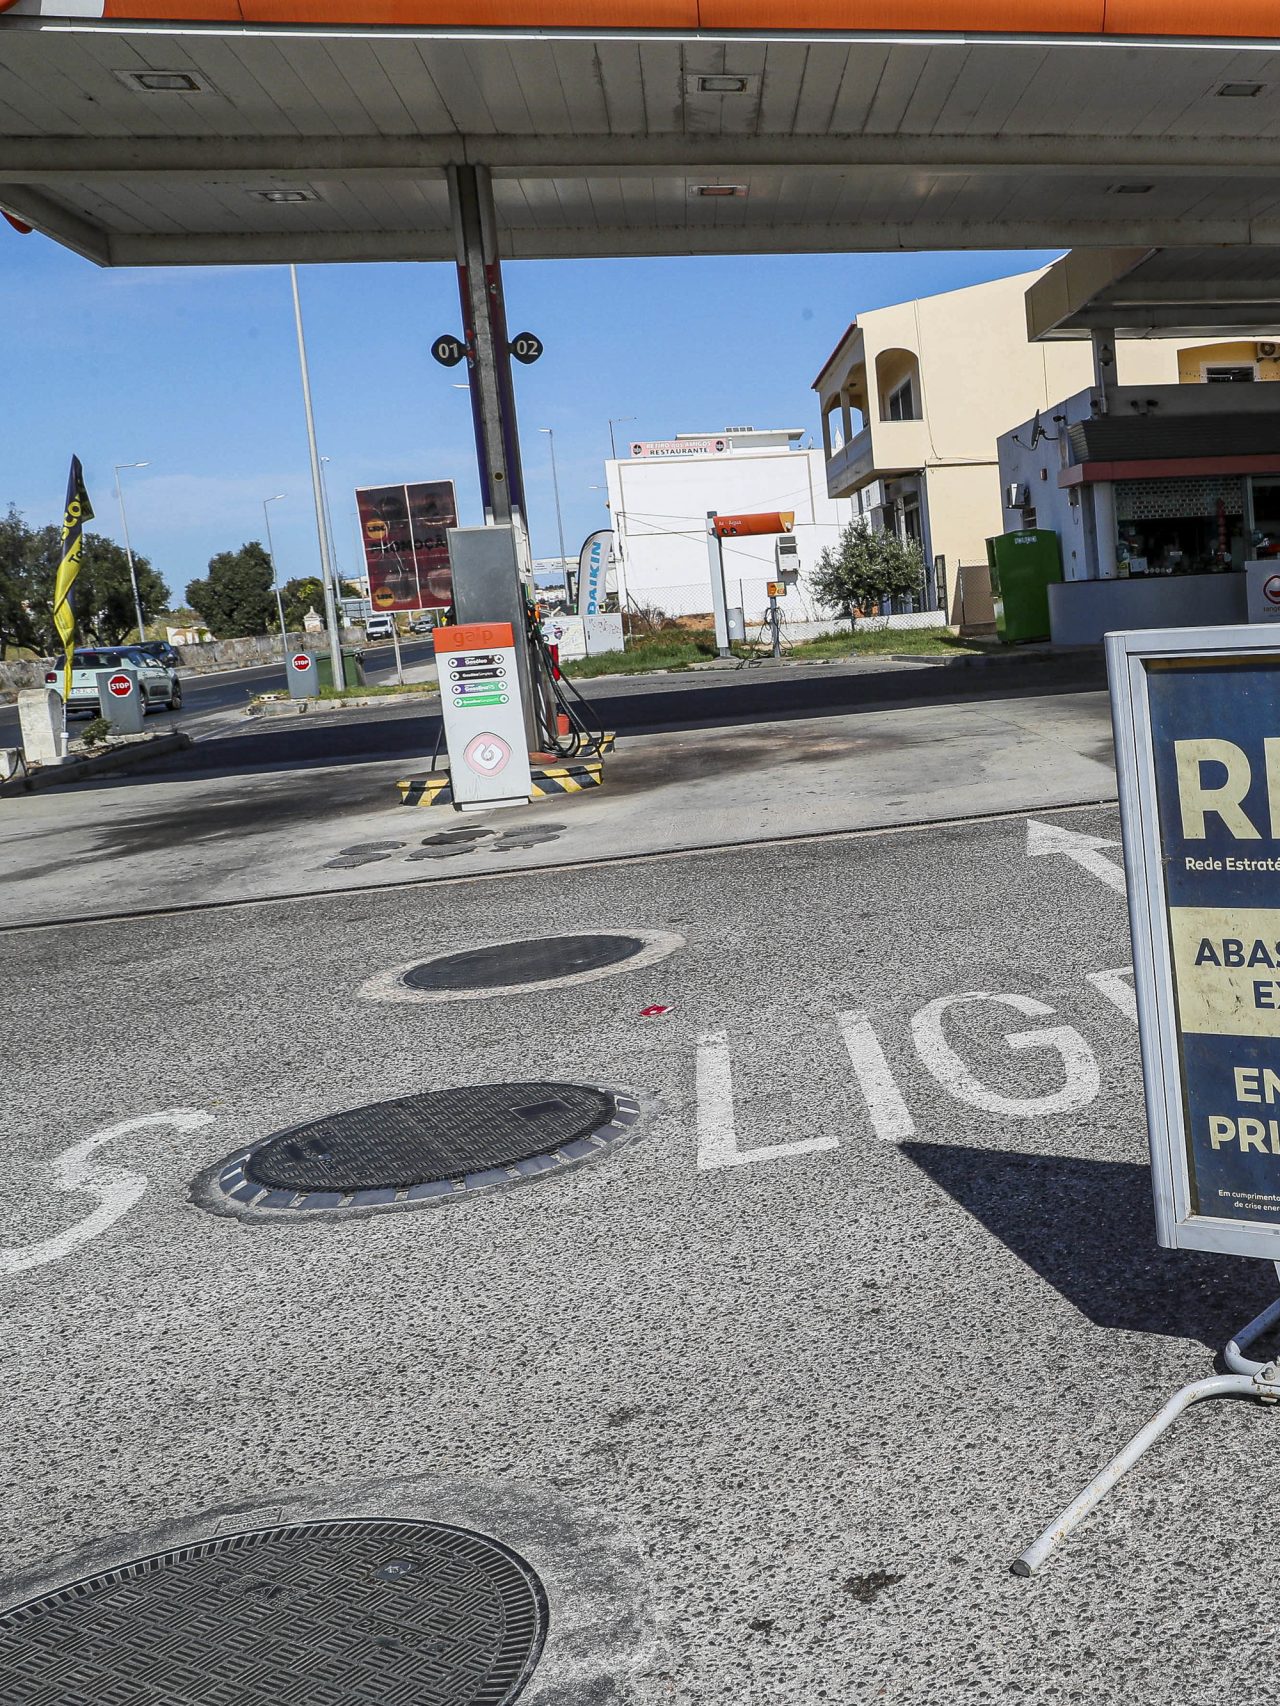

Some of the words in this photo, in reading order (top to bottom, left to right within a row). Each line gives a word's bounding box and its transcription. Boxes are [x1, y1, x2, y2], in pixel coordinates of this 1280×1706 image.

[438, 343, 459, 359] 01
[516, 340, 539, 356] 02
[649, 447, 709, 456] RESTAURANTE
[587, 541, 602, 615] DAIKIN
[110, 682, 130, 690] STOP
[1185, 857, 1222, 871] Rede
[1218, 1189, 1231, 1198] Em
[1231, 1191, 1280, 1203] cumprimento
[1234, 1200, 1244, 1209] de
[1244, 1202, 1262, 1211] crise
